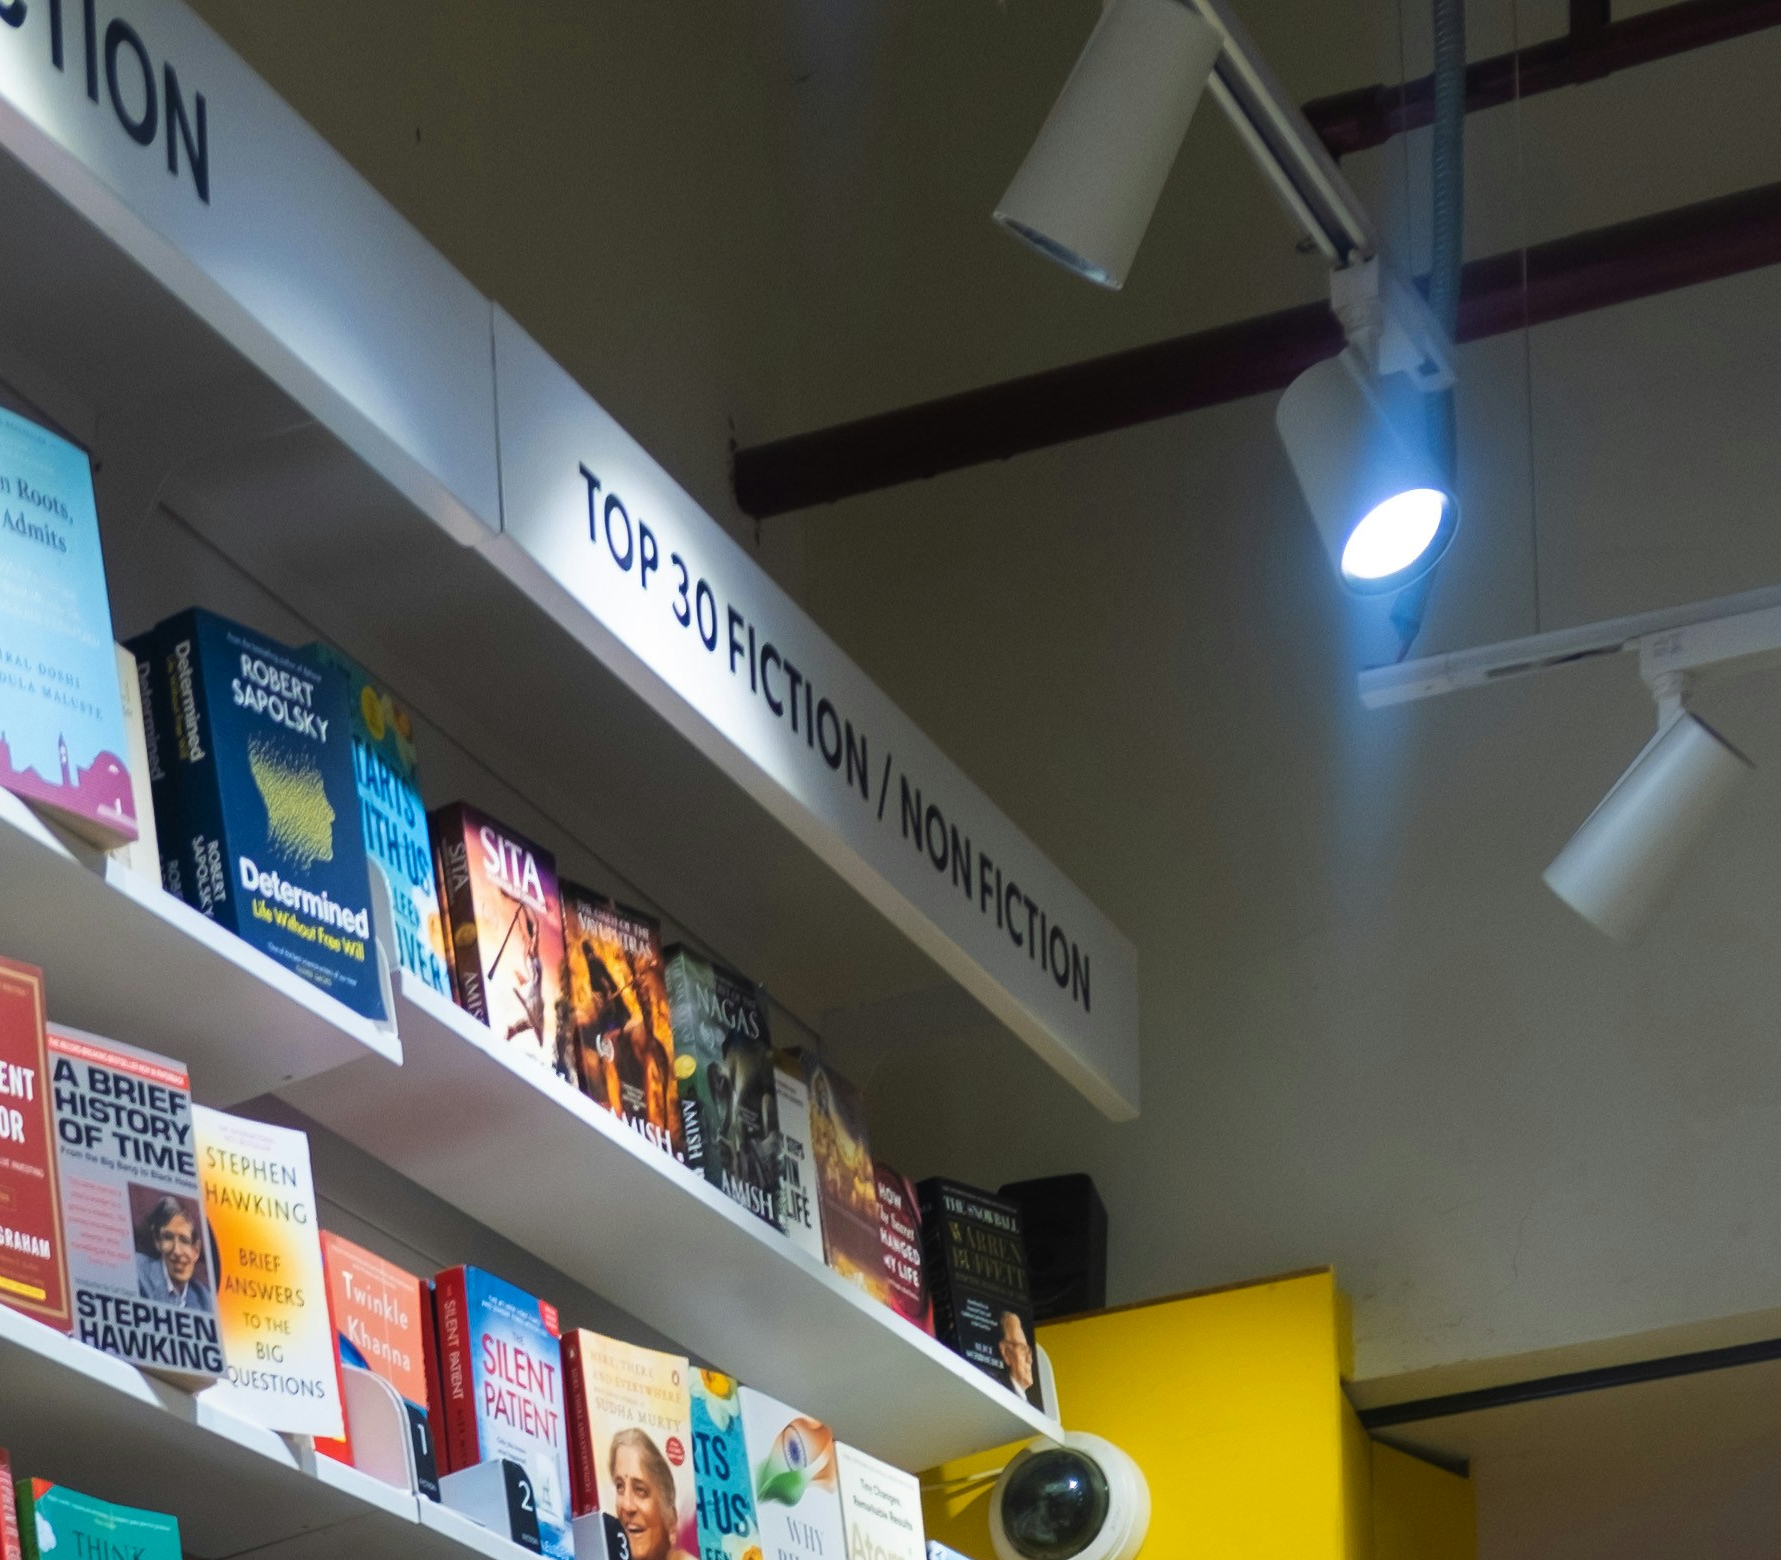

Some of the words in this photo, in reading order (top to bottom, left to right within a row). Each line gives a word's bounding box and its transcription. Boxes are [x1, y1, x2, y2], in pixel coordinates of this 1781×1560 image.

[240, 654, 313, 708] ROBERT
[232, 679, 330, 745] SAPOLSKY
[579, 461, 659, 592] TOP
[671, 552, 718, 653] 30
[729, 603, 869, 801] FICTION
[877, 753, 892, 820] /
[900, 774, 973, 900] NON
[980, 858, 1091, 1014] FICTION
[478, 827, 547, 903] SITA
[238, 855, 370, 940] Determined
[52, 1058, 79, 1087] A
[87, 1063, 186, 1116] BRIEF
[54, 1083, 191, 1146] HISTORY
[57, 1118, 100, 1148] OF
[120, 1128, 196, 1176] TIME
[238, 1248, 281, 1274] BRIEF
[77, 1290, 217, 1344] STEPHEN
[225, 1277, 305, 1309] ANSWERS
[80, 1319, 222, 1372] HAWKING
[242, 1312, 261, 1331] TO
[265, 1317, 290, 1335] THE
[255, 1342, 284, 1363] BIG
[481, 1332, 556, 1404] SILENT
[227, 1367, 324, 1399] QUESTIONS
[484, 1392, 560, 1448] PATIENT
